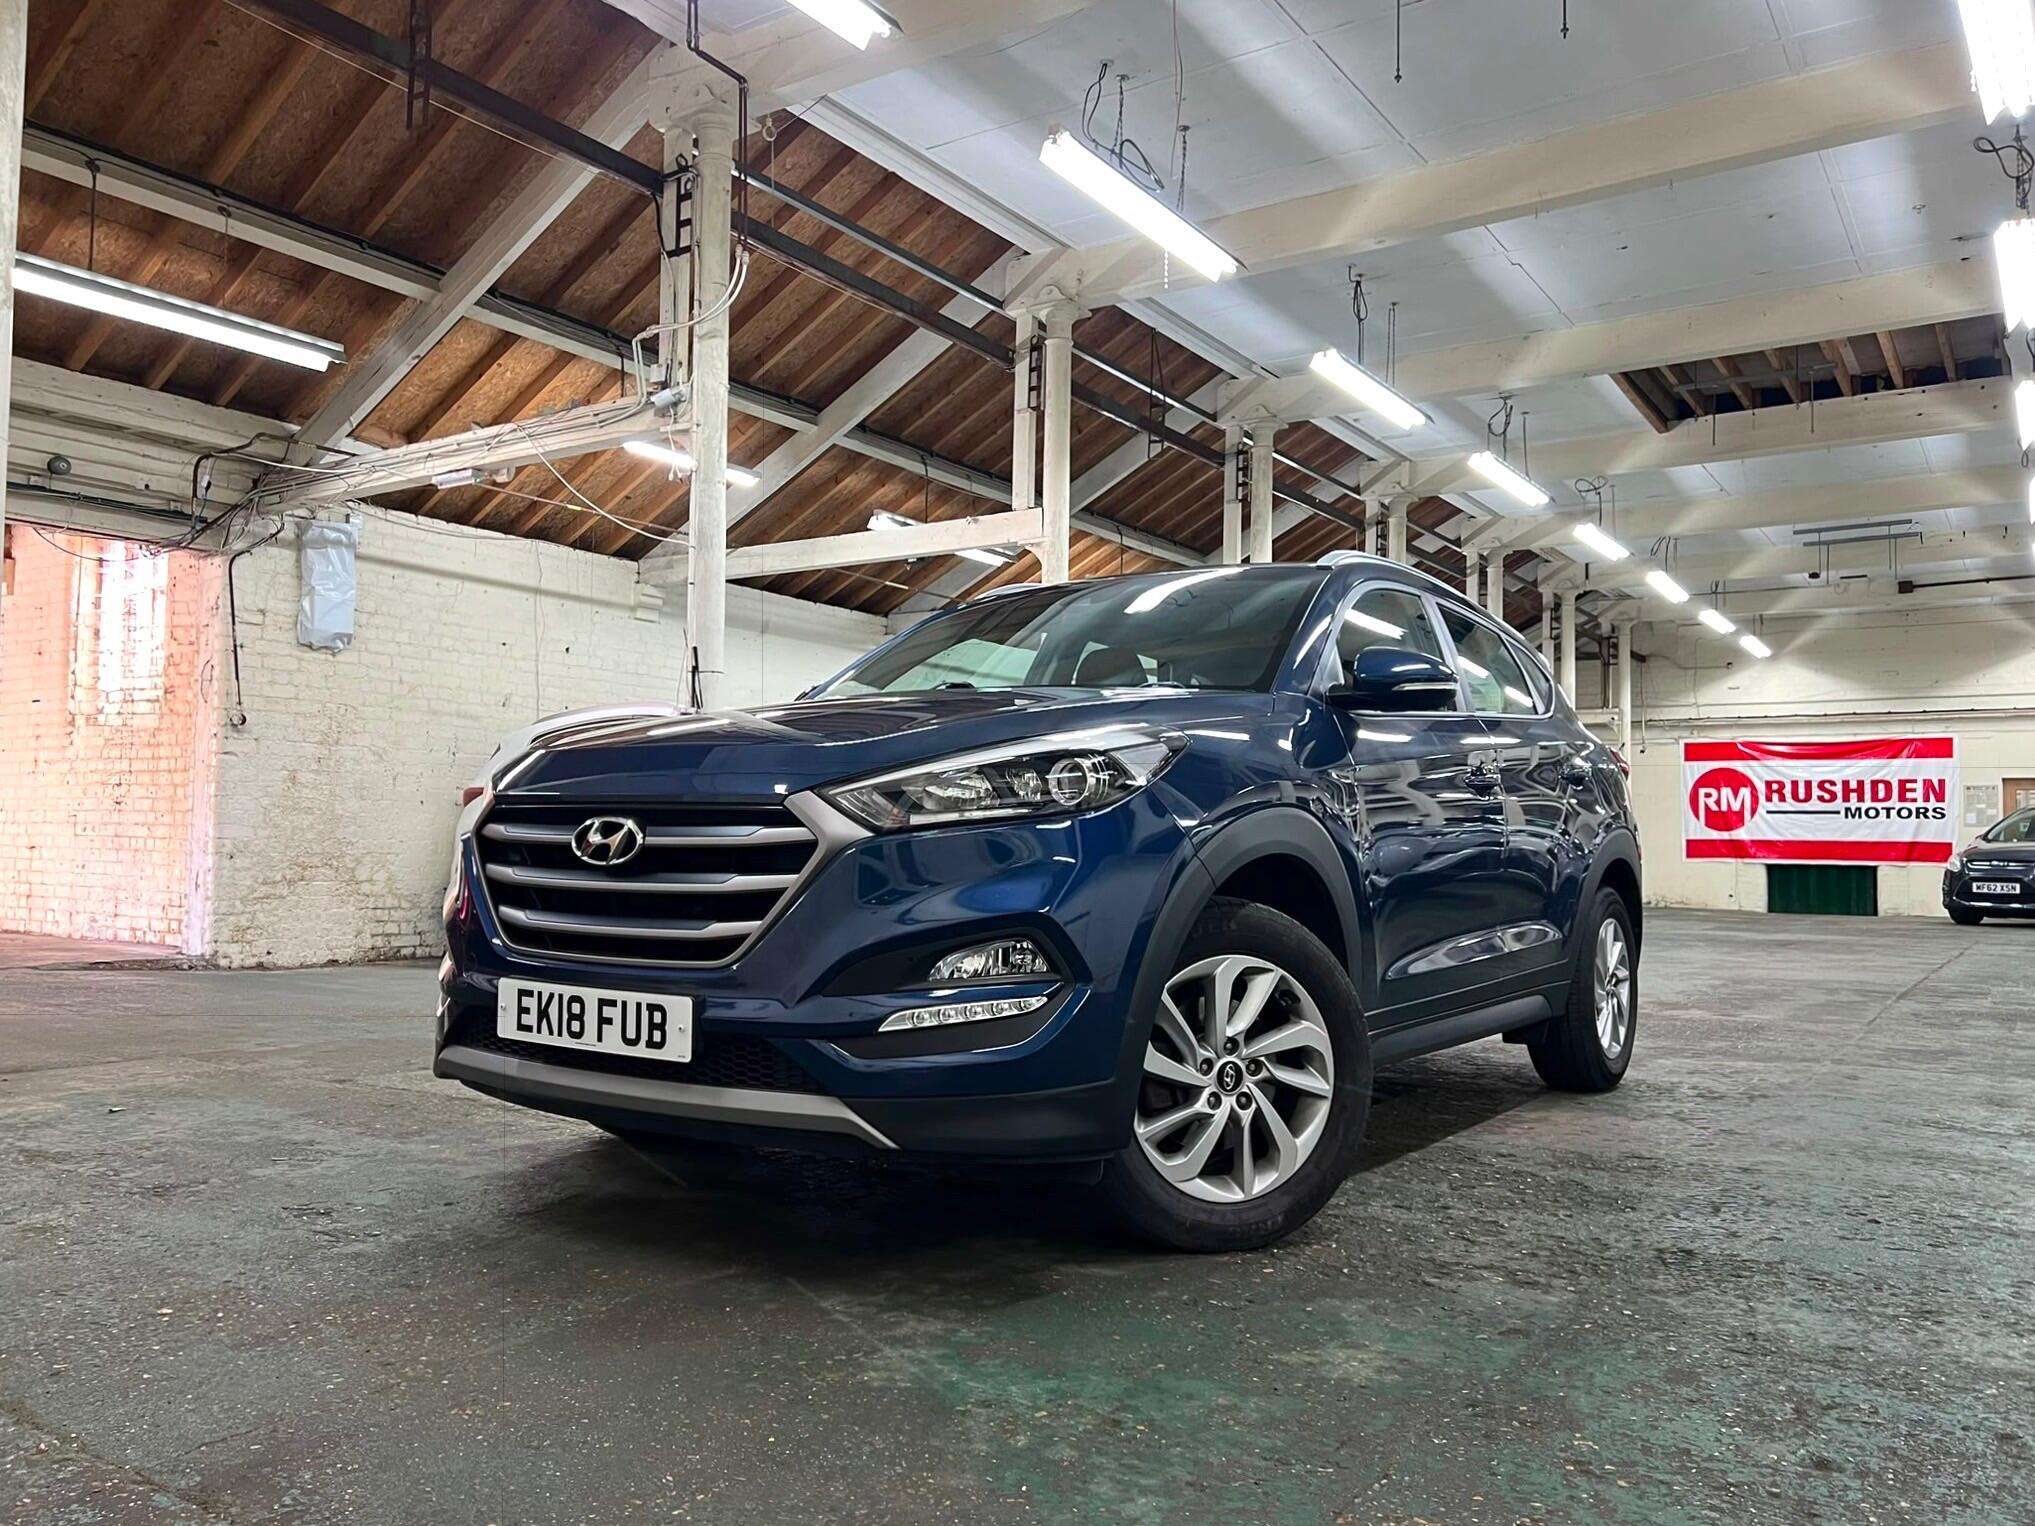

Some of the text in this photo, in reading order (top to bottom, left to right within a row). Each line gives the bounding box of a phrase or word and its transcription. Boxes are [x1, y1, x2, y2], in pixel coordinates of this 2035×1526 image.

[1698, 786, 1750, 816] RM
[1764, 778, 1946, 803] RUSHDEN
[1844, 806, 1947, 820] MOTORS
[516, 988, 668, 1050] EK18 FUB
